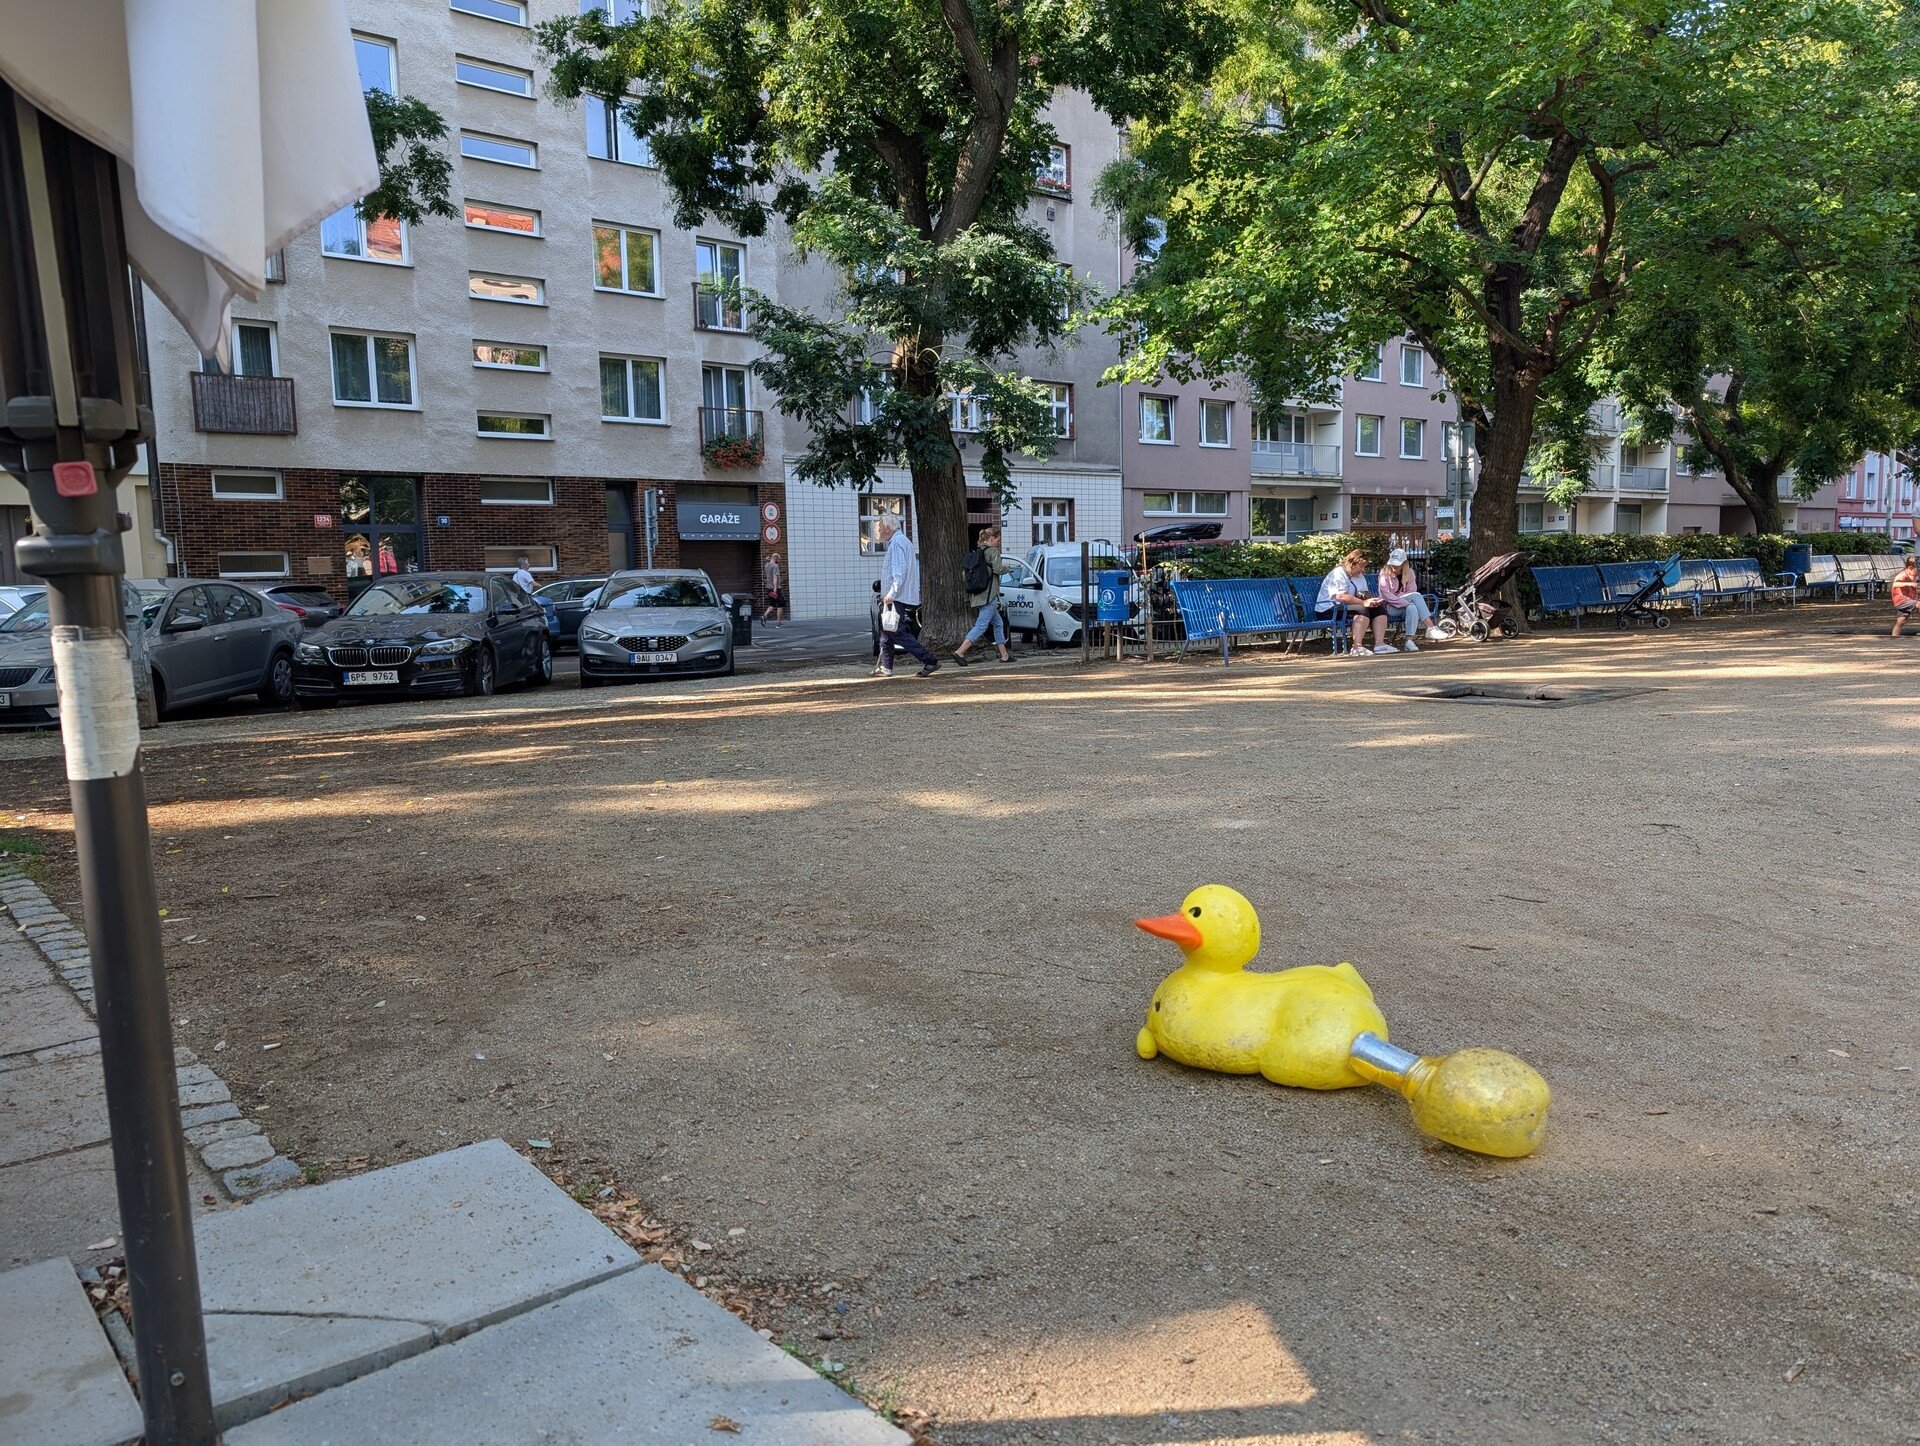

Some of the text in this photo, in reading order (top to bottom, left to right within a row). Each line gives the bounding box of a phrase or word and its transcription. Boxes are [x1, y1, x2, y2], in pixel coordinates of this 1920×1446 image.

[699, 512, 740, 524] GARÁŽE
[1008, 600, 1034, 609] zenova
[636, 653, 674, 662] 9AU 0347
[350, 672, 394, 682] 6P5 9762
